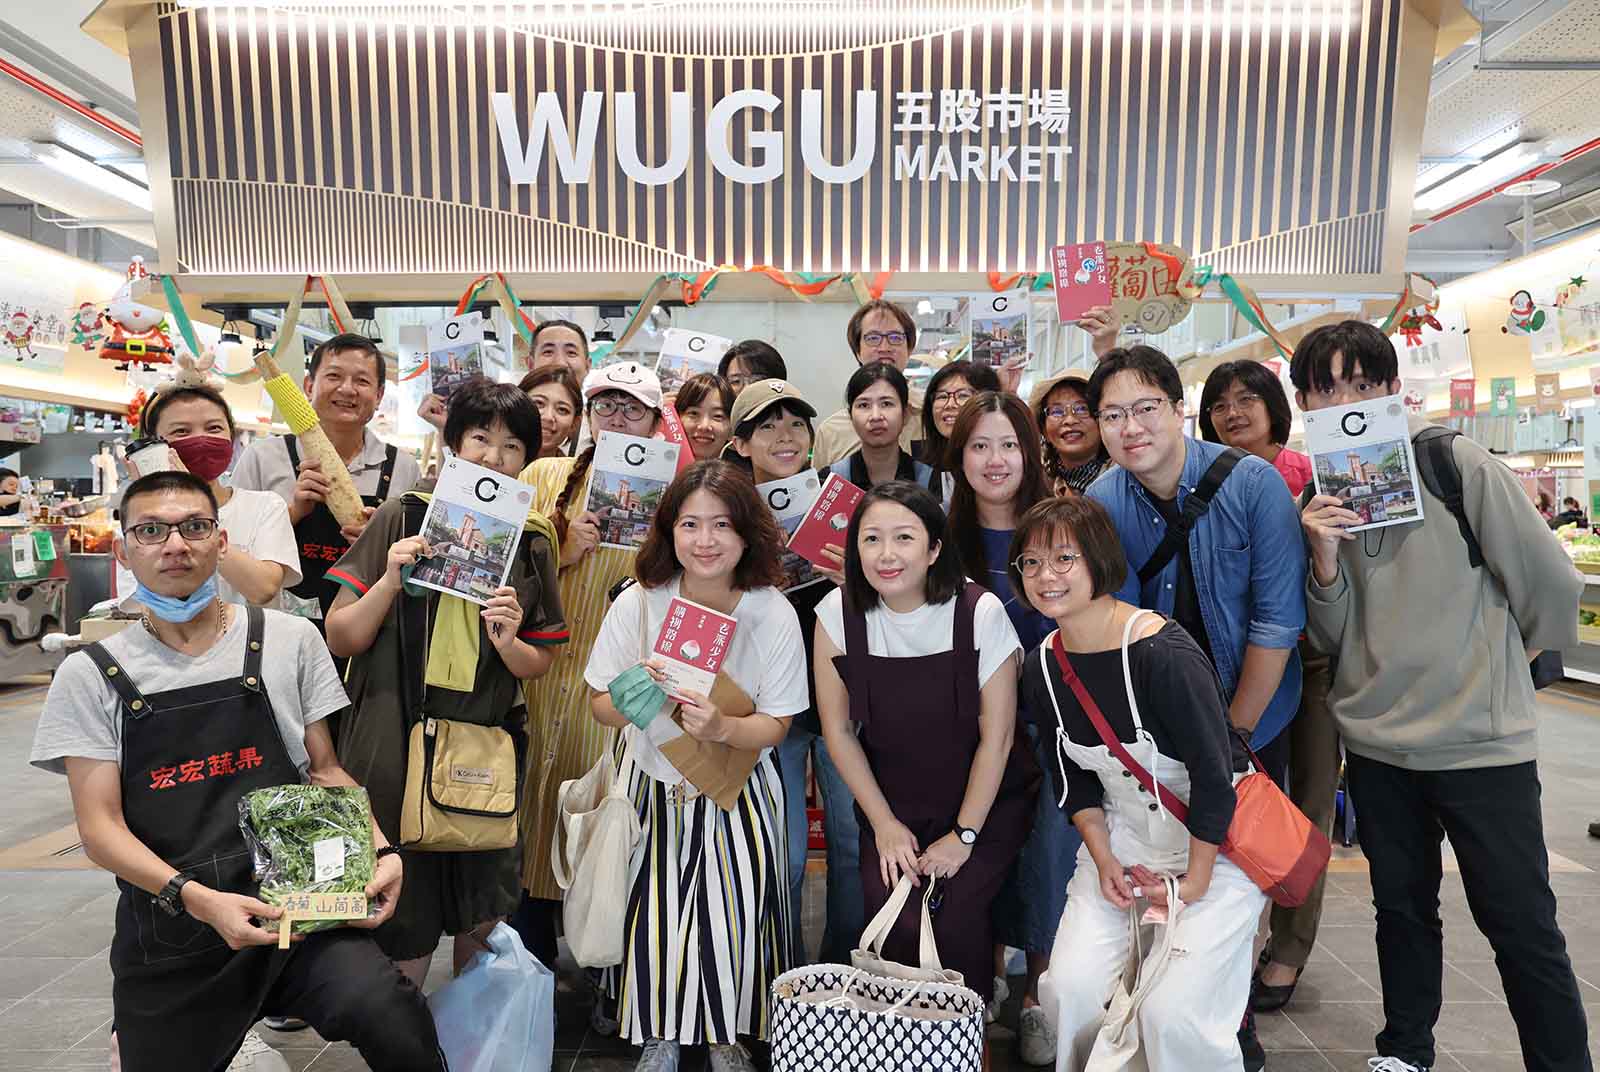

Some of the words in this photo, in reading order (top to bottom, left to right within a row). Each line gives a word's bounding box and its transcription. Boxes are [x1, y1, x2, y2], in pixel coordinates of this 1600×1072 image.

[894, 89, 1071, 133] 五股市場
[490, 89, 876, 185] WUGU
[895, 145, 1072, 183] MARKET
[150, 747, 264, 791] 宏宏蔬果
